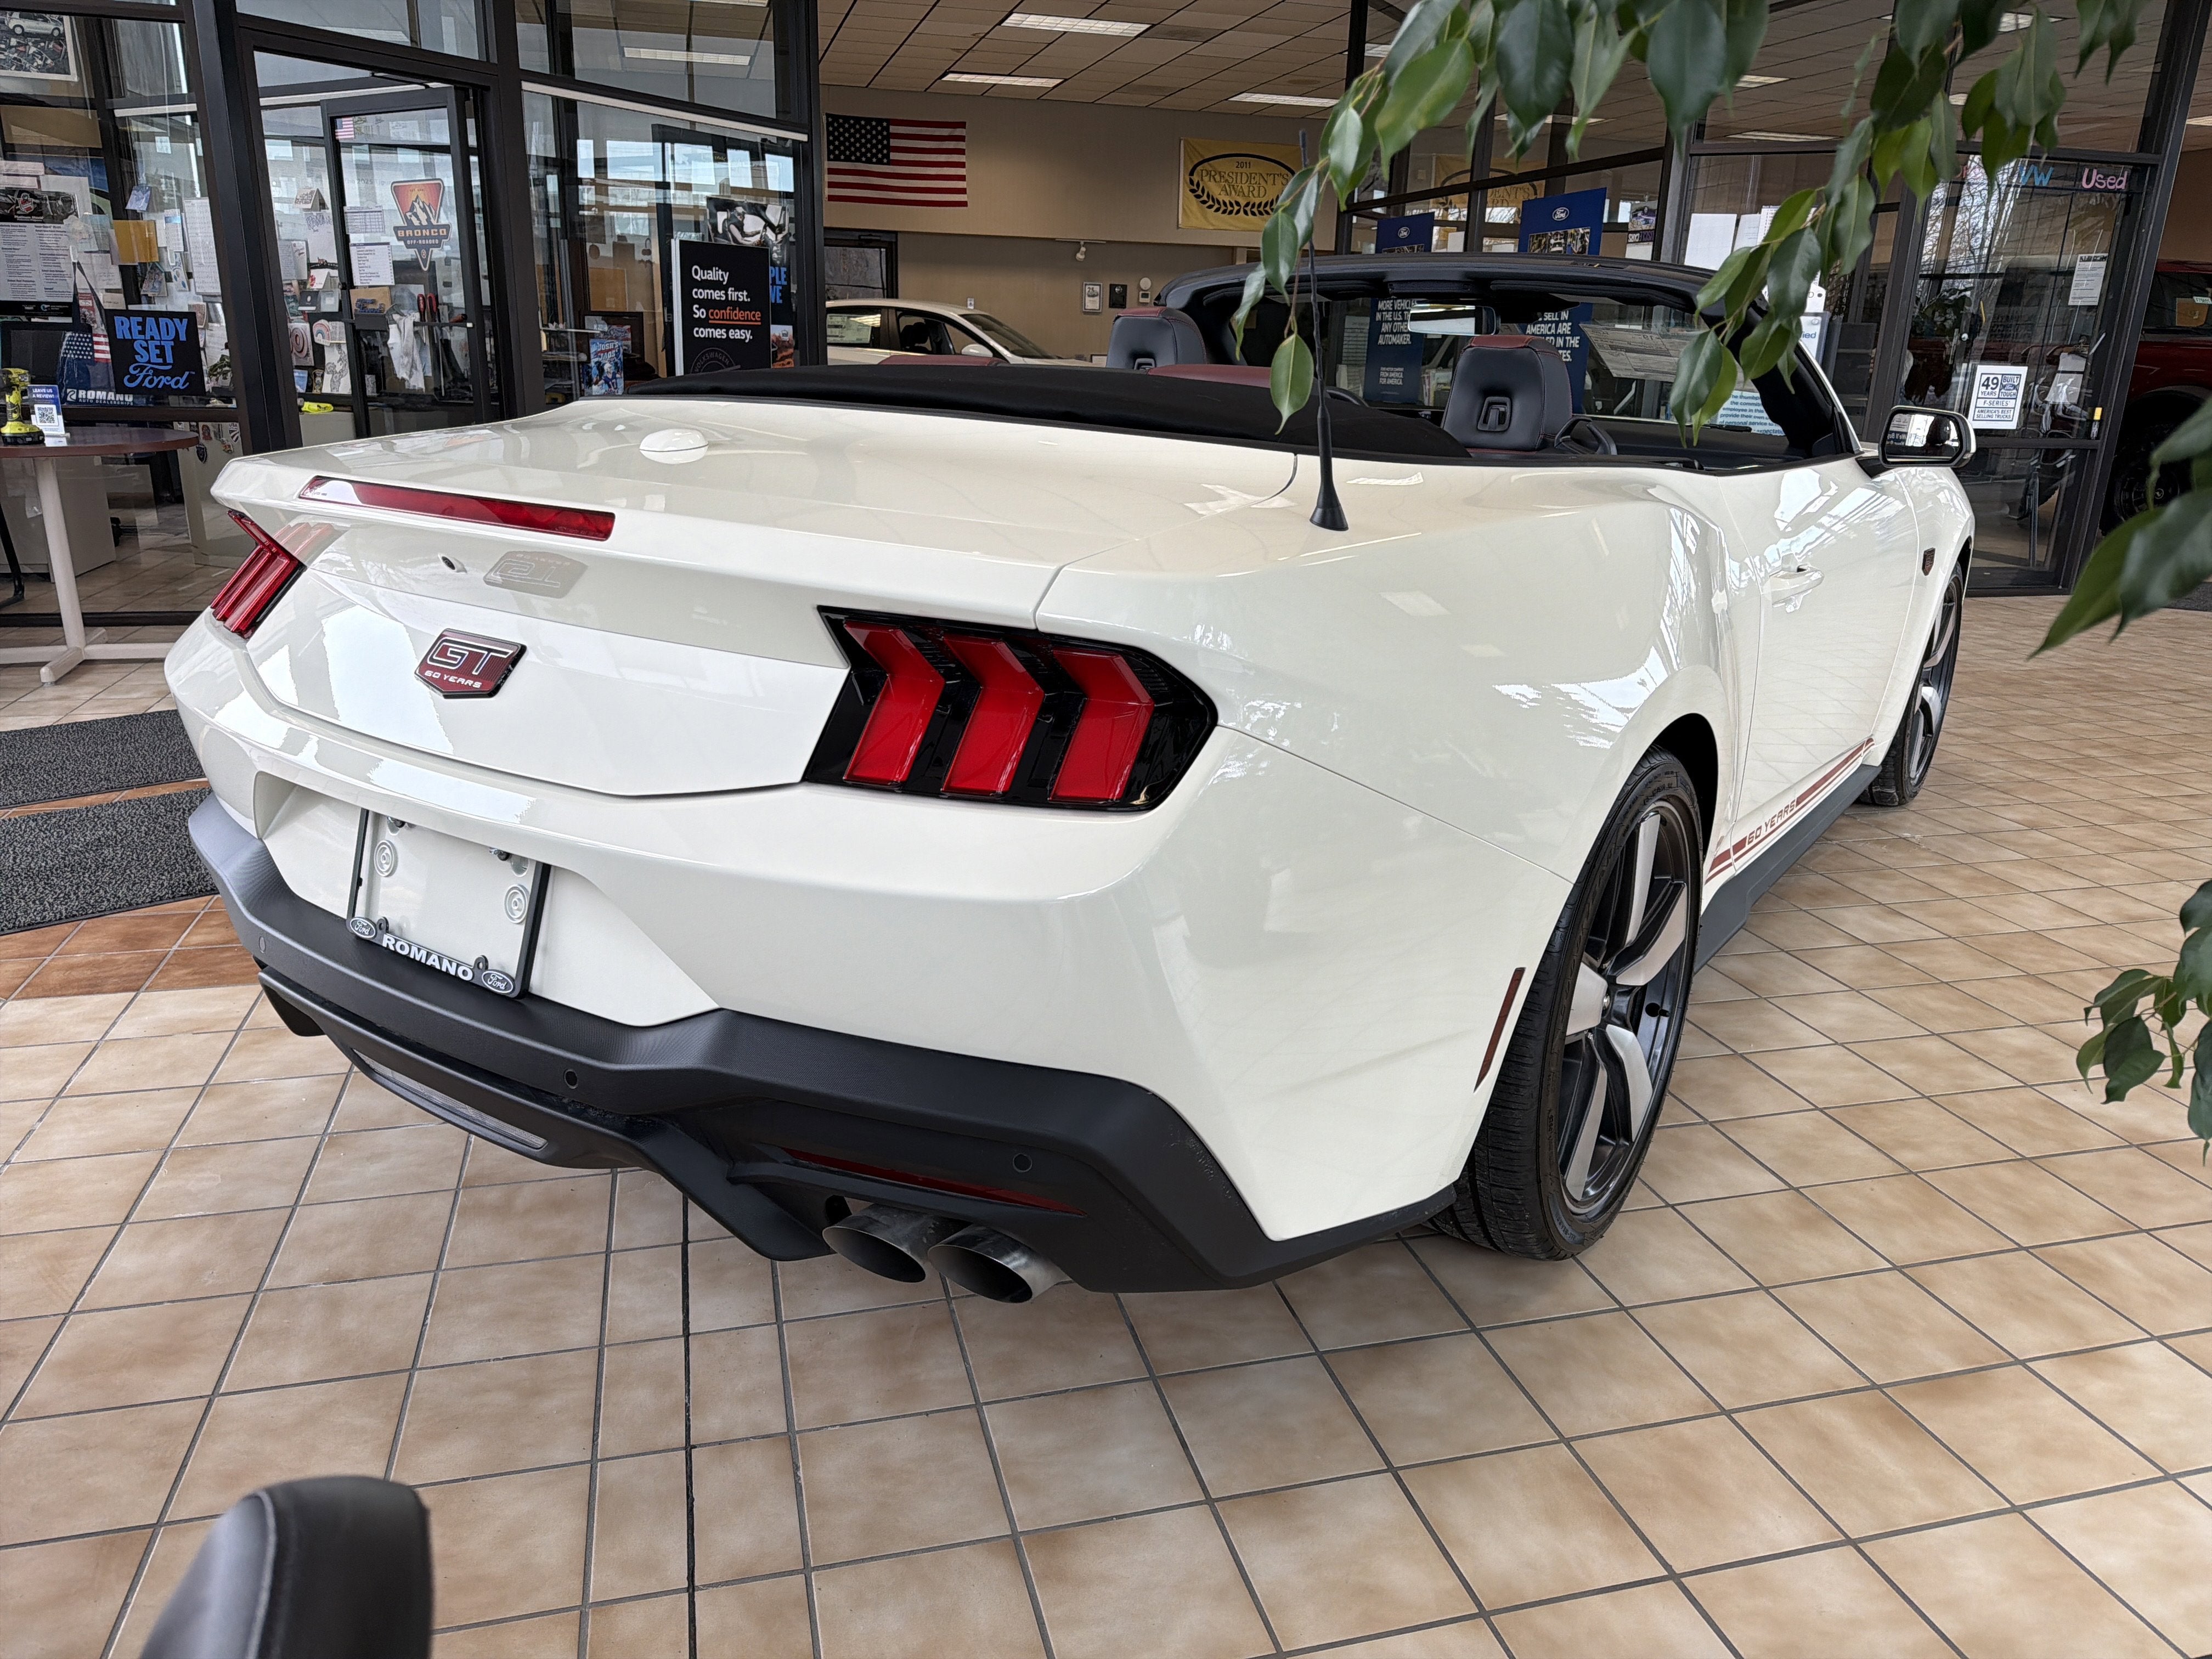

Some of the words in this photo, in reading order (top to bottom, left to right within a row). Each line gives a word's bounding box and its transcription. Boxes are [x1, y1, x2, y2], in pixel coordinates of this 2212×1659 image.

[1200, 169, 1289, 185] PRESIDENT'S
[2019, 165, 2054, 187] VW
[2081, 167, 2128, 190] Used
[1218, 184, 1267, 198] AWARD
[397, 228, 447, 237] BRONCO
[692, 265, 729, 285] Quality
[692, 288, 726, 301] comes
[728, 287, 751, 302] first.
[693, 304, 706, 318] So
[709, 306, 761, 320] confidence
[1378, 300, 1393, 311] MORE
[1376, 312, 1382, 321] IN
[1382, 311, 1392, 321] THE
[1393, 311, 1403, 320] U.S.
[1544, 312, 1559, 321] SELL
[1561, 310, 1569, 320] IN
[114, 316, 188, 341] READY
[1381, 322, 1392, 332] ANY
[1393, 322, 1408, 332] OTHE
[1526, 323, 1556, 335] AMERICA
[1556, 322, 1572, 335] ARE
[693, 328, 727, 339] comes
[729, 329, 753, 343] easy.
[1378, 334, 1412, 345] AUTOMAKER.
[1556, 336, 1564, 347] IN
[1565, 336, 1580, 347] THE
[133, 340, 174, 363] SET
[695, 352, 730, 373] VOLKSWAGEN
[123, 363, 189, 390] Ford
[1982, 376, 1999, 390] 49
[78, 390, 133, 402] ROMANO
[427, 636, 514, 675] GT
[425, 669, 441, 679] 60
[443, 674, 482, 689] YEARS
[1747, 825, 1762, 845] 60
[1764, 799, 1796, 832] YEARS
[354, 922, 371, 935] Ford
[382, 934, 473, 981] ROMANO
[487, 974, 507, 990] Ford
